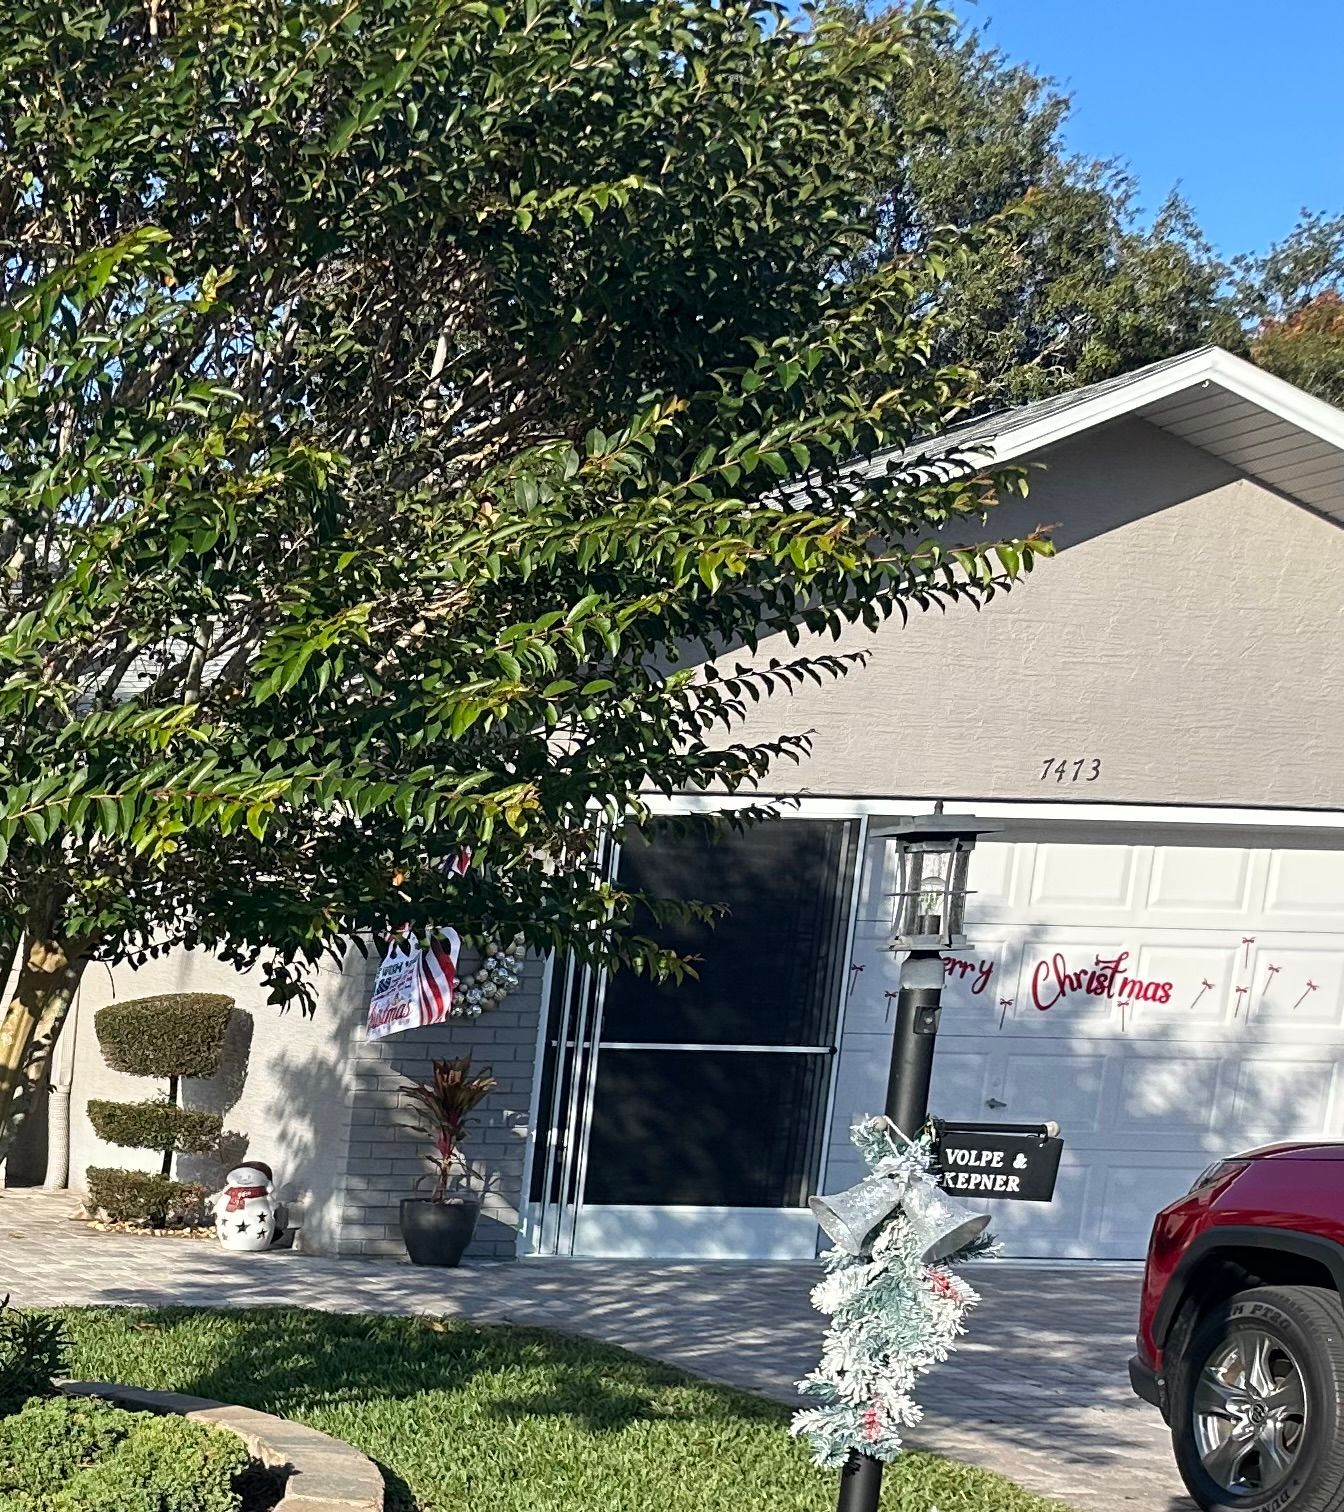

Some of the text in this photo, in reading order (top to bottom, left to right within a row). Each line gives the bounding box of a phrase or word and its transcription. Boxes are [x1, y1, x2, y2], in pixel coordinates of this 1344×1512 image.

[1041, 758, 1101, 782] 7473
[942, 951, 1173, 1011] erry Christmas
[945, 1148, 1028, 1169] VOLPE &
[941, 1171, 1020, 1192] KEPNER
